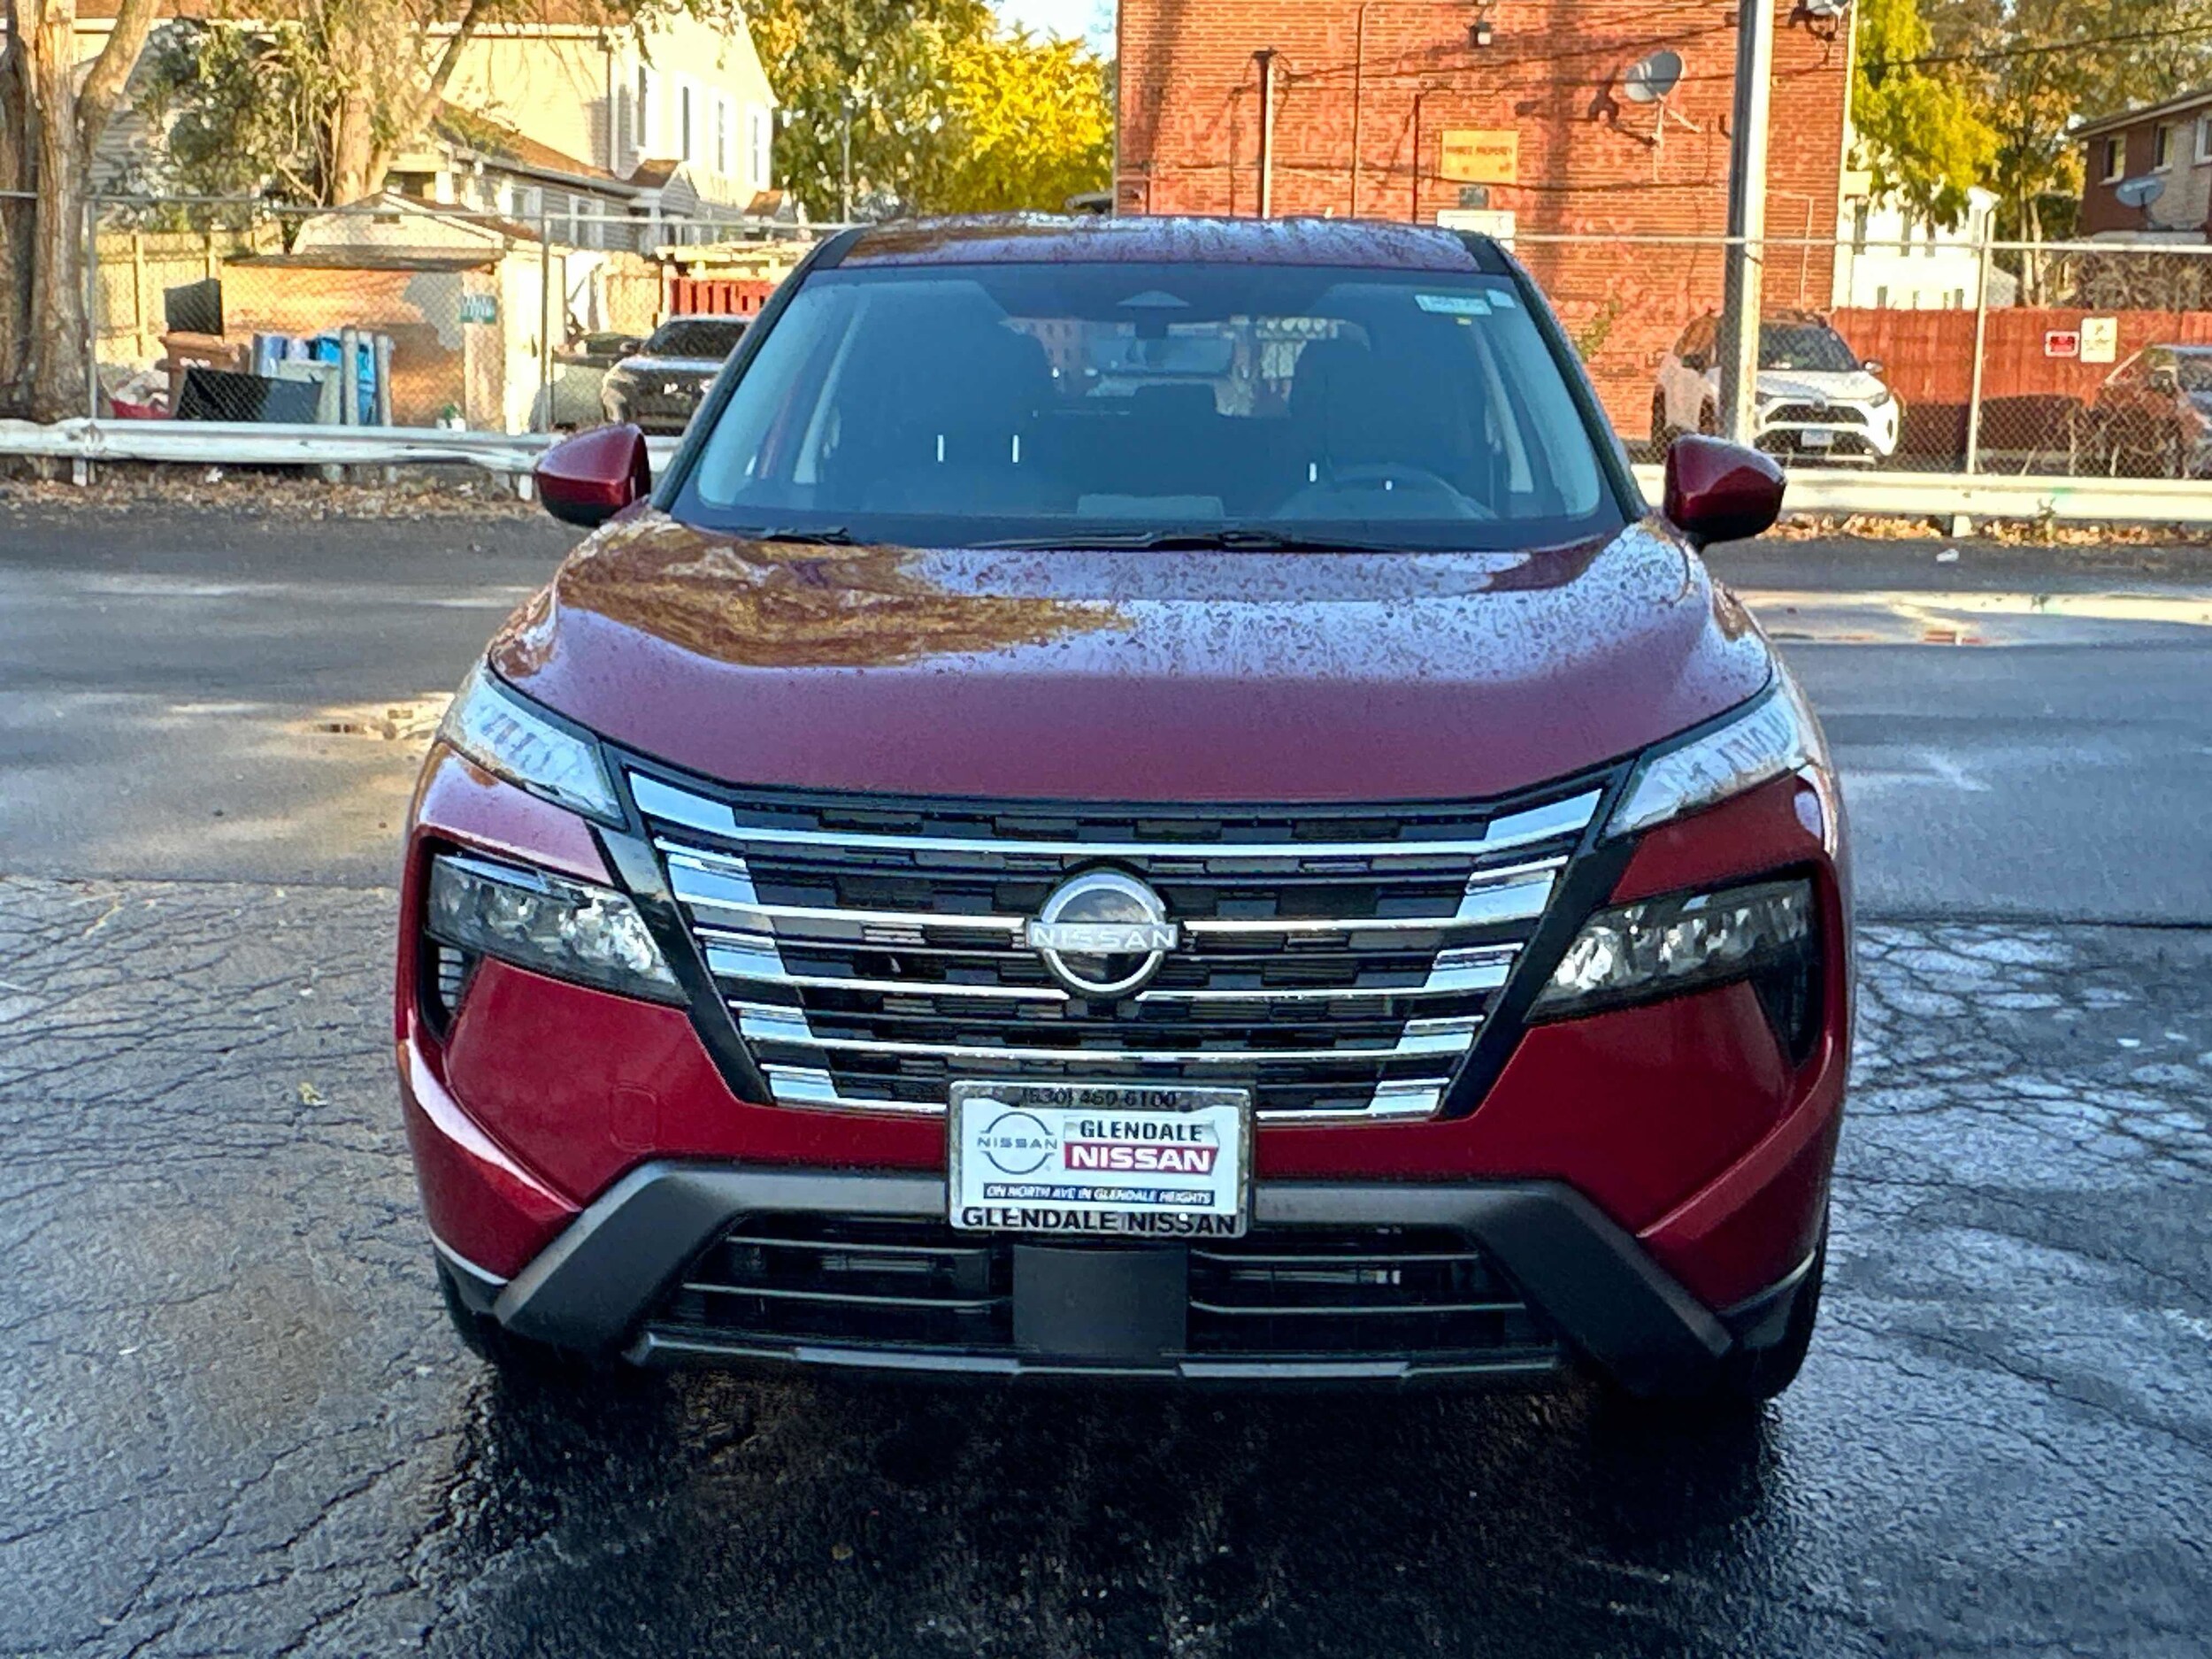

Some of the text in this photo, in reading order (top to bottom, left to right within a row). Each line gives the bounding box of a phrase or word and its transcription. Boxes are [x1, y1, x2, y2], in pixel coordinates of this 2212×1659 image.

[1032, 928, 1175, 949] NISSAN
[1079, 1118, 1203, 1142] GLENDALE
[976, 1136, 1058, 1150] NISSAN
[1071, 1145, 1210, 1172] NISSAN
[987, 1185, 1211, 1204] ON NORTH AVE IN GLENDALE HEIGHTS
[961, 1206, 1237, 1235] GLENDALE NISSAN
